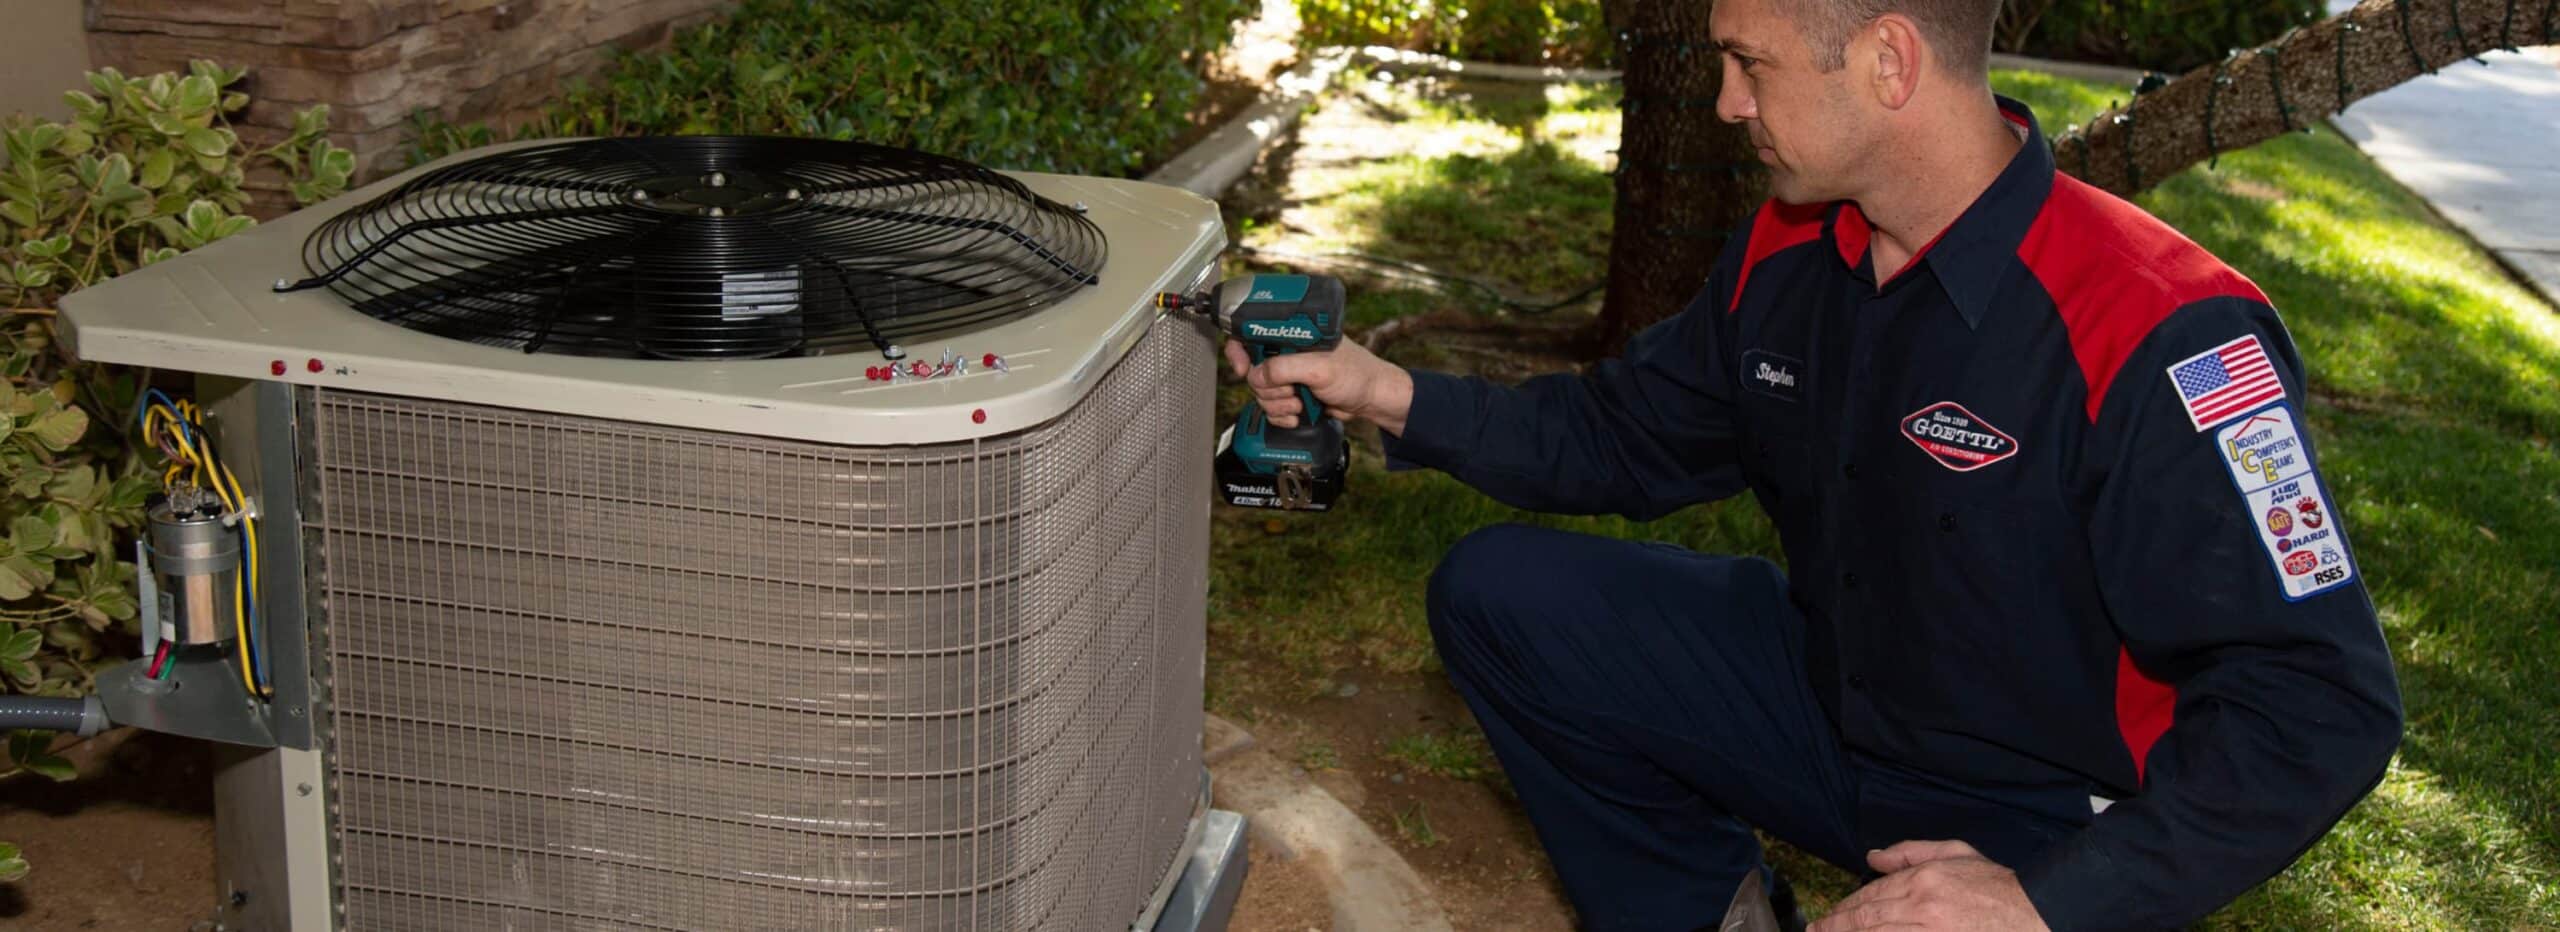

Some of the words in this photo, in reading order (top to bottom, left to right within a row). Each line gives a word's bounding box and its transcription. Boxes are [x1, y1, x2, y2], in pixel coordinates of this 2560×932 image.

[1248, 323, 1314, 339] Makita
[2226, 428, 2273, 462] INDUSTRY
[1226, 483, 1276, 496] Makita
[2292, 528, 2330, 548] HARDI
[2314, 565, 2345, 586] RSES
